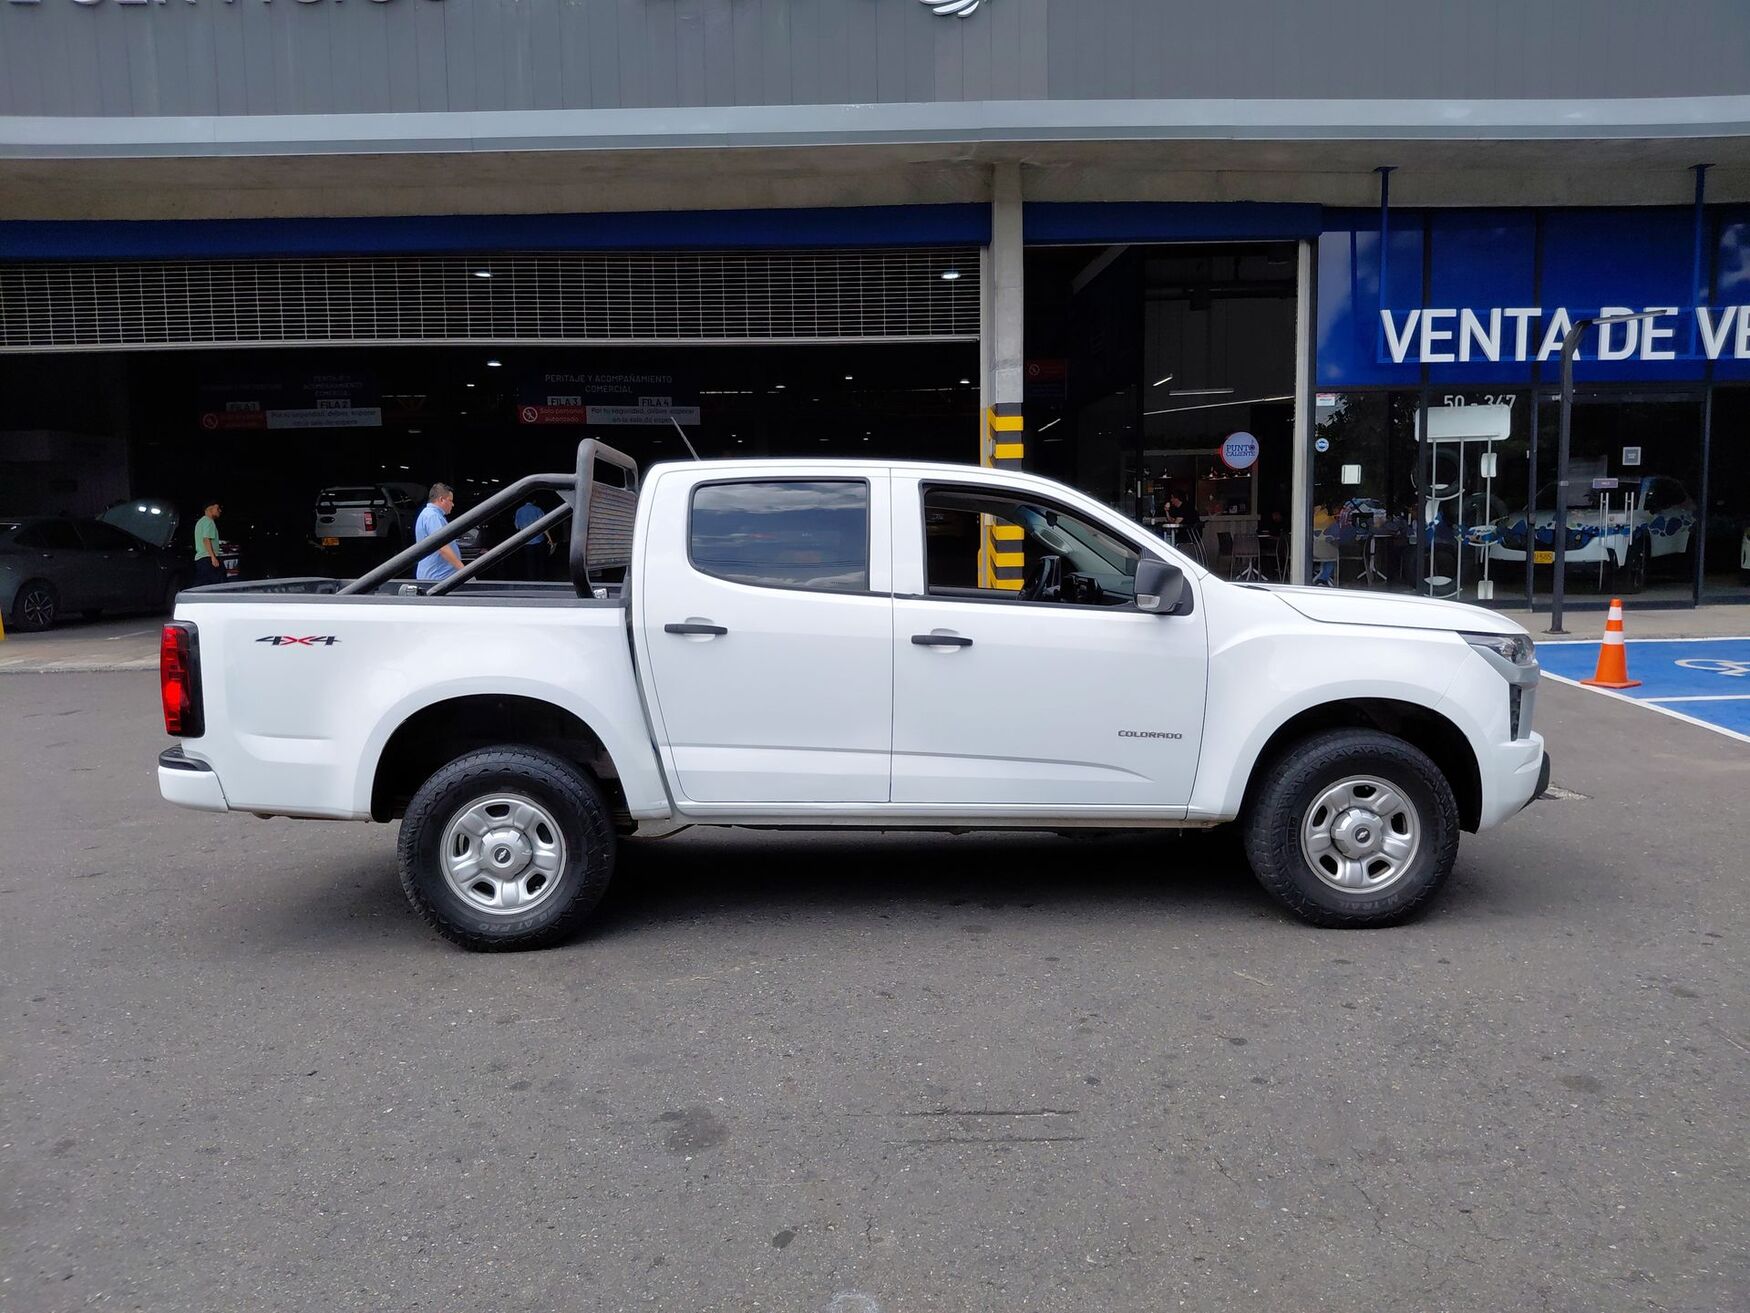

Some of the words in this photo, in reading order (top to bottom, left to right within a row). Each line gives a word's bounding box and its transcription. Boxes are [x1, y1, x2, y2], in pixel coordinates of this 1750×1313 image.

[1379, 306, 1580, 363] VENTA
[1597, 306, 1678, 361] DE
[545, 374, 585, 383] PERITAJE
[588, 374, 593, 382] Y
[585, 385, 632, 393] COMERCIAL
[550, 397, 571, 406] FILA
[642, 398, 662, 407] FILA
[1443, 394, 1465, 408] 50
[1484, 394, 1517, 409] 347
[1226, 444, 1256, 452] PUNTO
[1117, 729, 1183, 740] COLORADO
